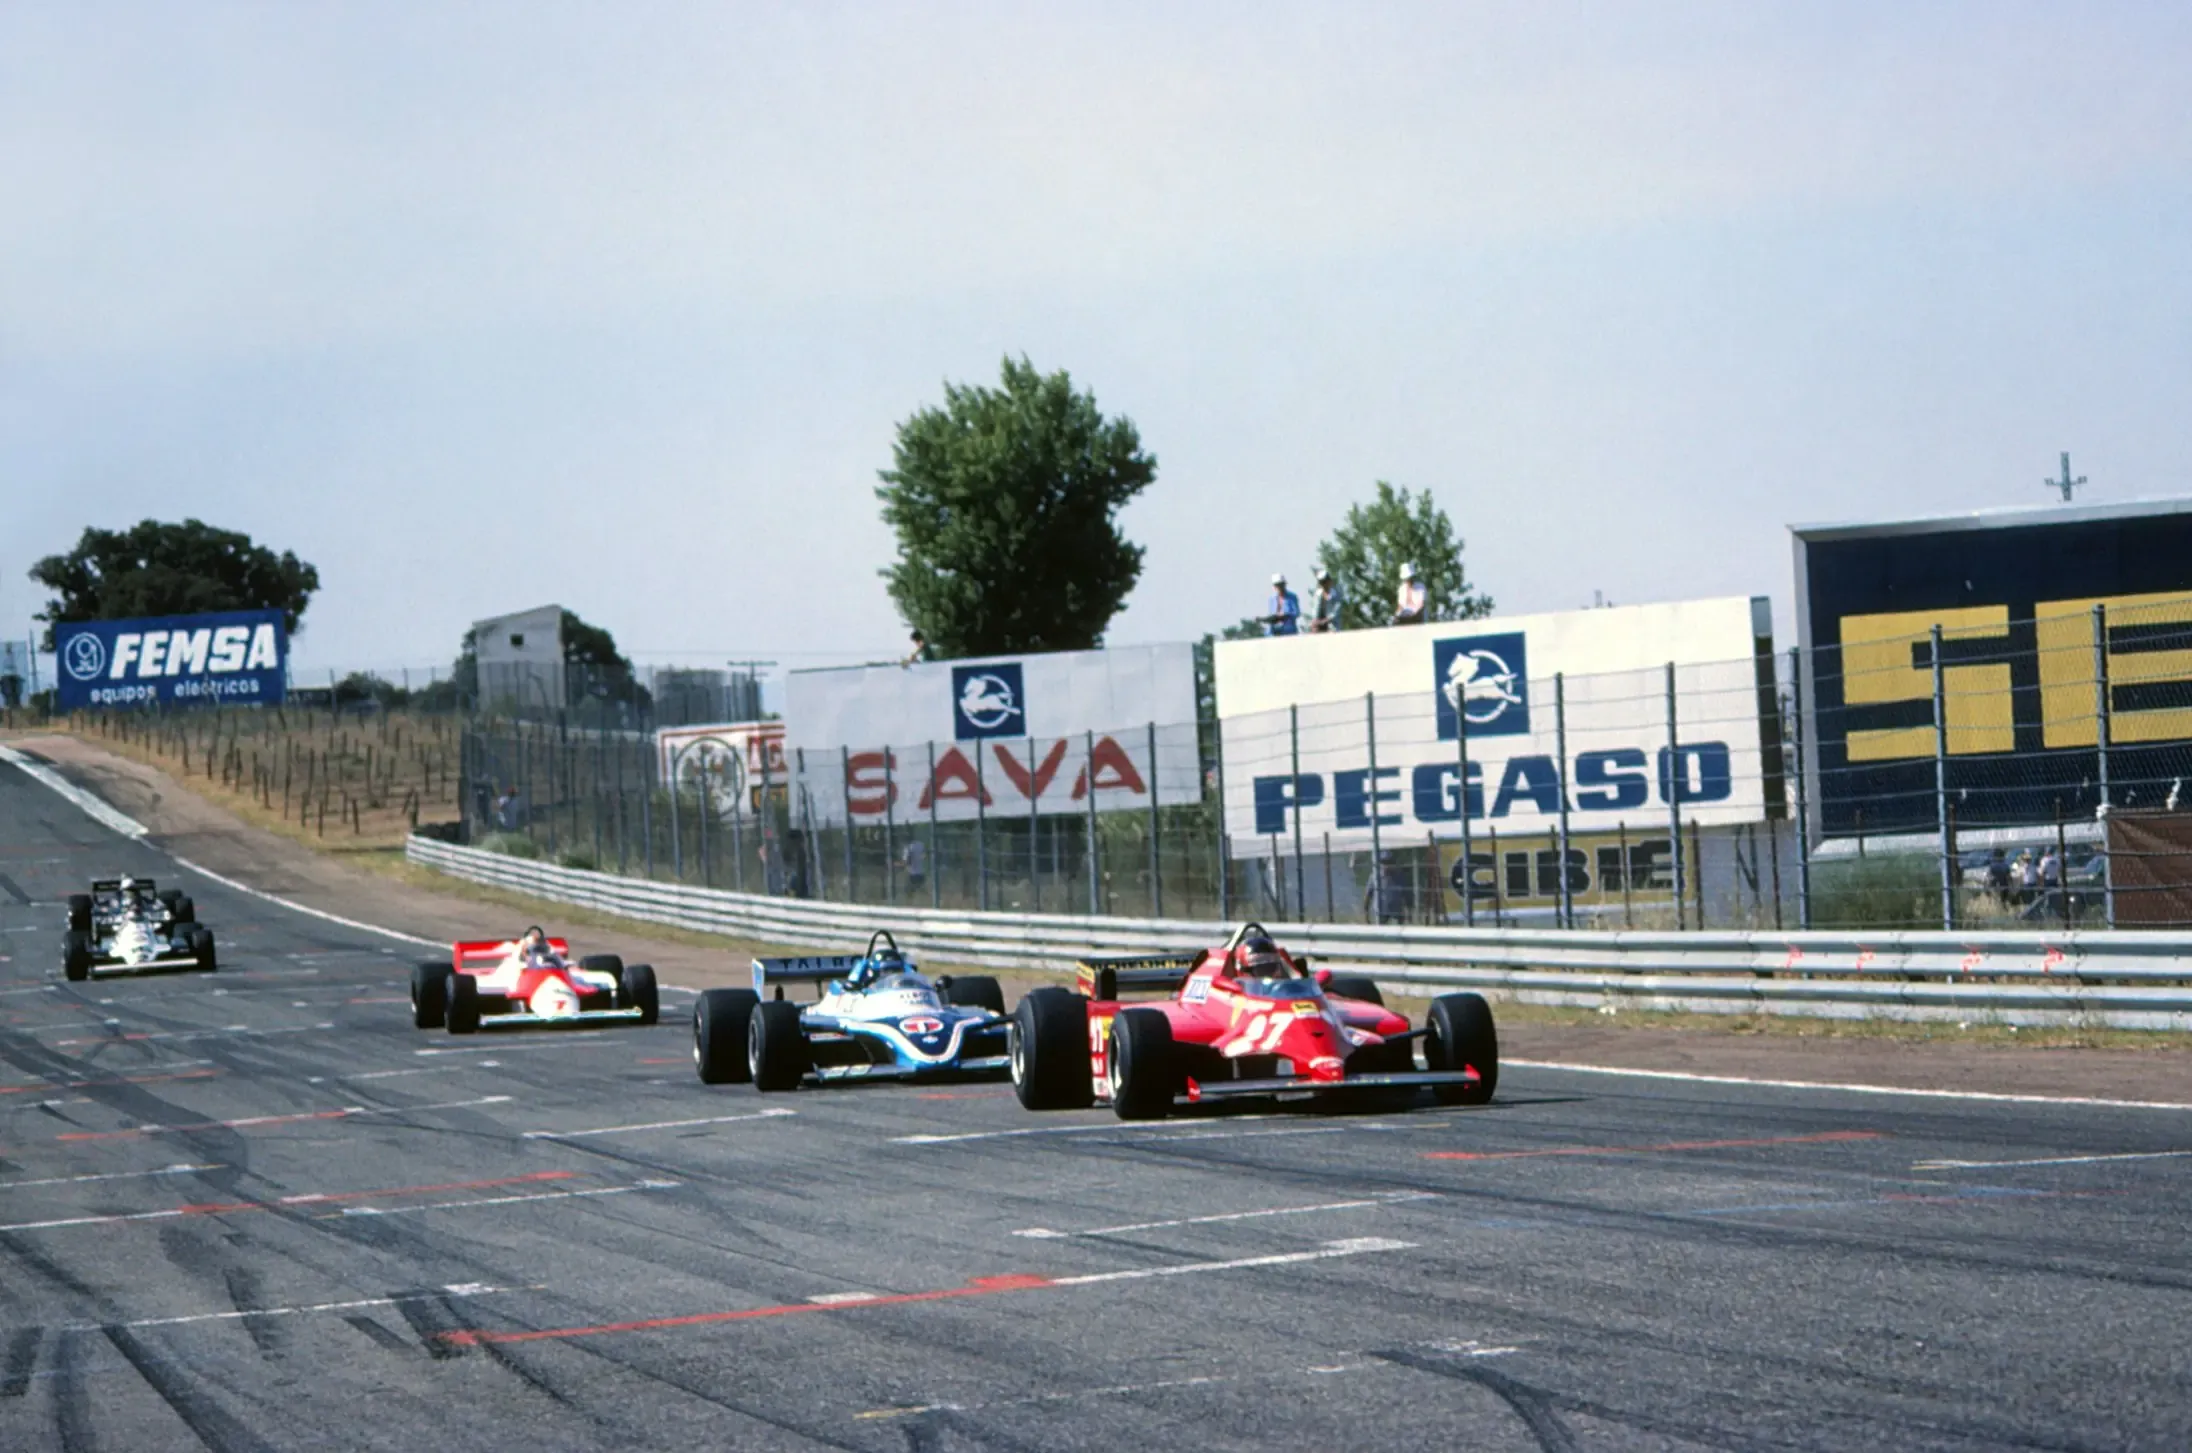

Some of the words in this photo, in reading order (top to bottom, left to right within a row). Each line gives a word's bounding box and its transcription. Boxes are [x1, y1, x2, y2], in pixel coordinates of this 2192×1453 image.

[108, 623, 278, 680] FEMSA
[90, 684, 156, 704] equipos
[844, 735, 1146, 814] SAVA
[1253, 740, 1732, 834] PEGASO
[1451, 838, 1685, 900] CIBIE
[1223, 1011, 1294, 1058] 27
